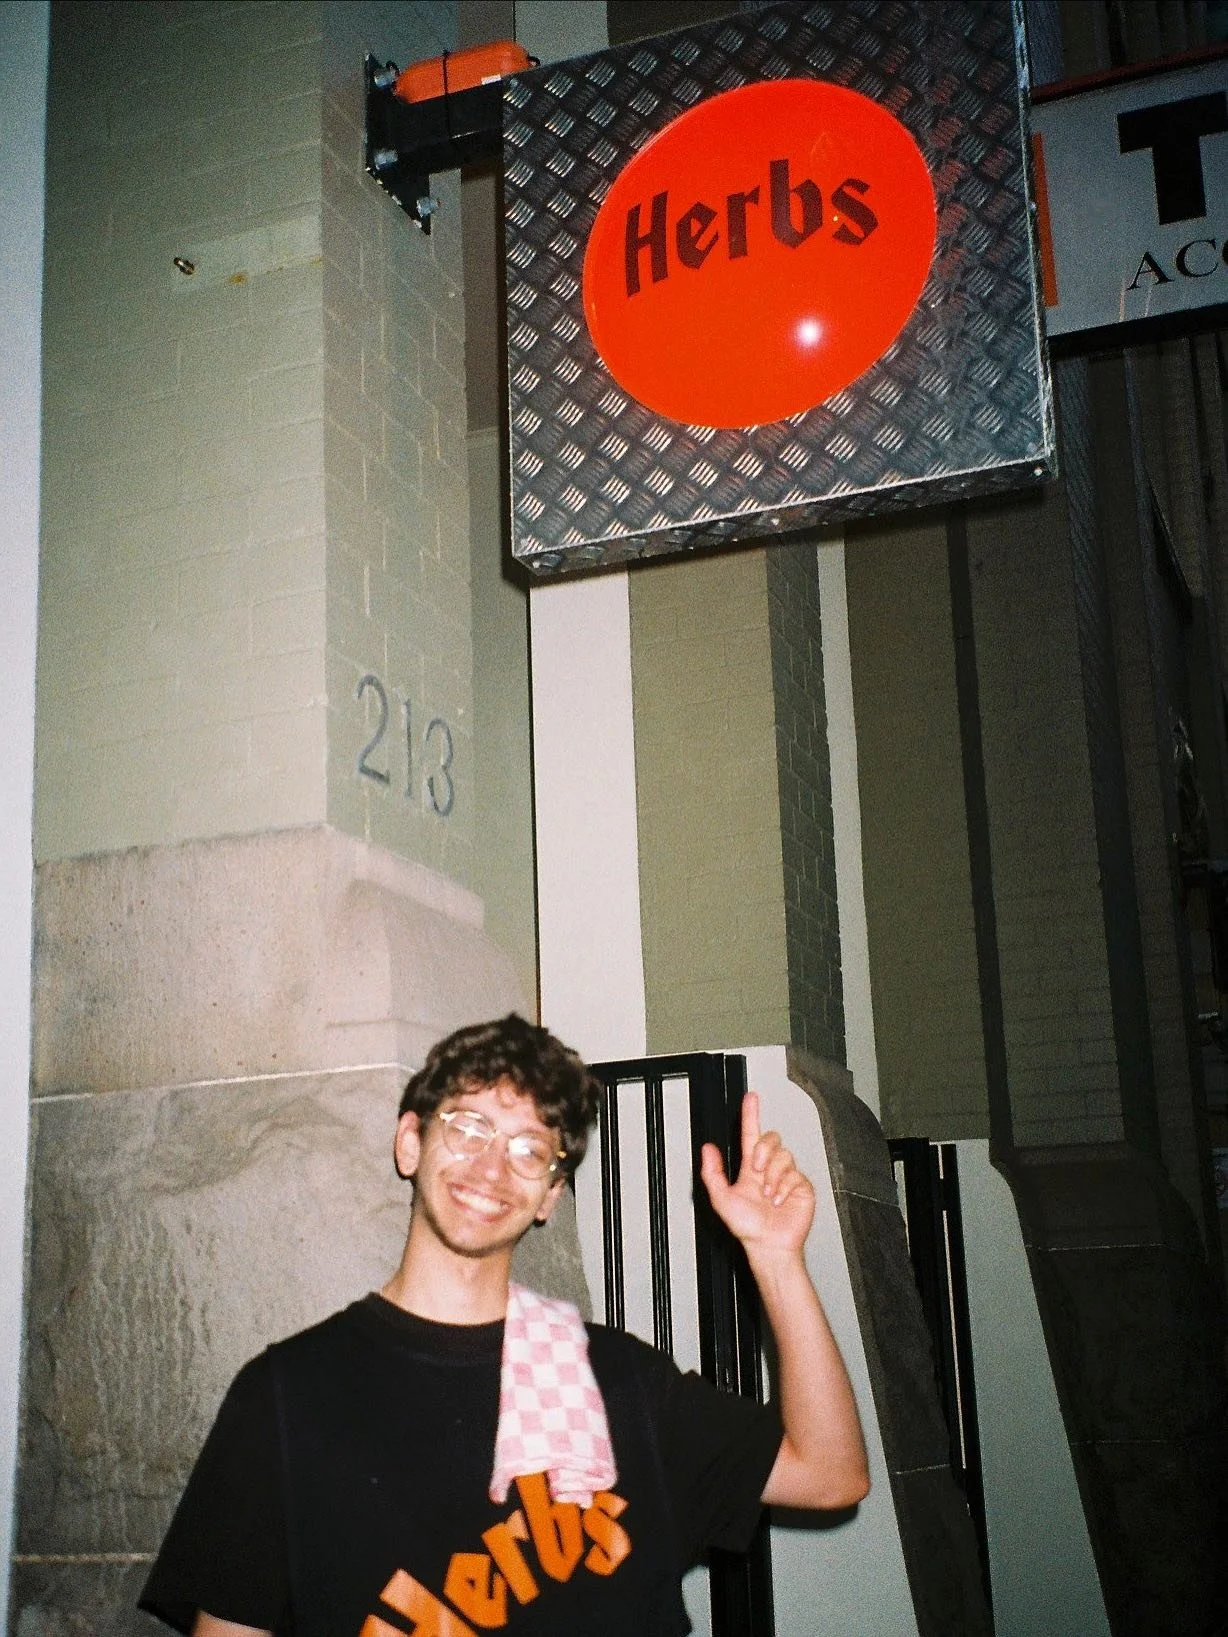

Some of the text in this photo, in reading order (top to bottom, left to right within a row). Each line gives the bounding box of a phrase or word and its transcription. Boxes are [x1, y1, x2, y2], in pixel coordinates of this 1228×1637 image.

[624, 158, 879, 298] Herbs
[1126, 238, 1228, 291] AC
[356, 673, 455, 817] 213
